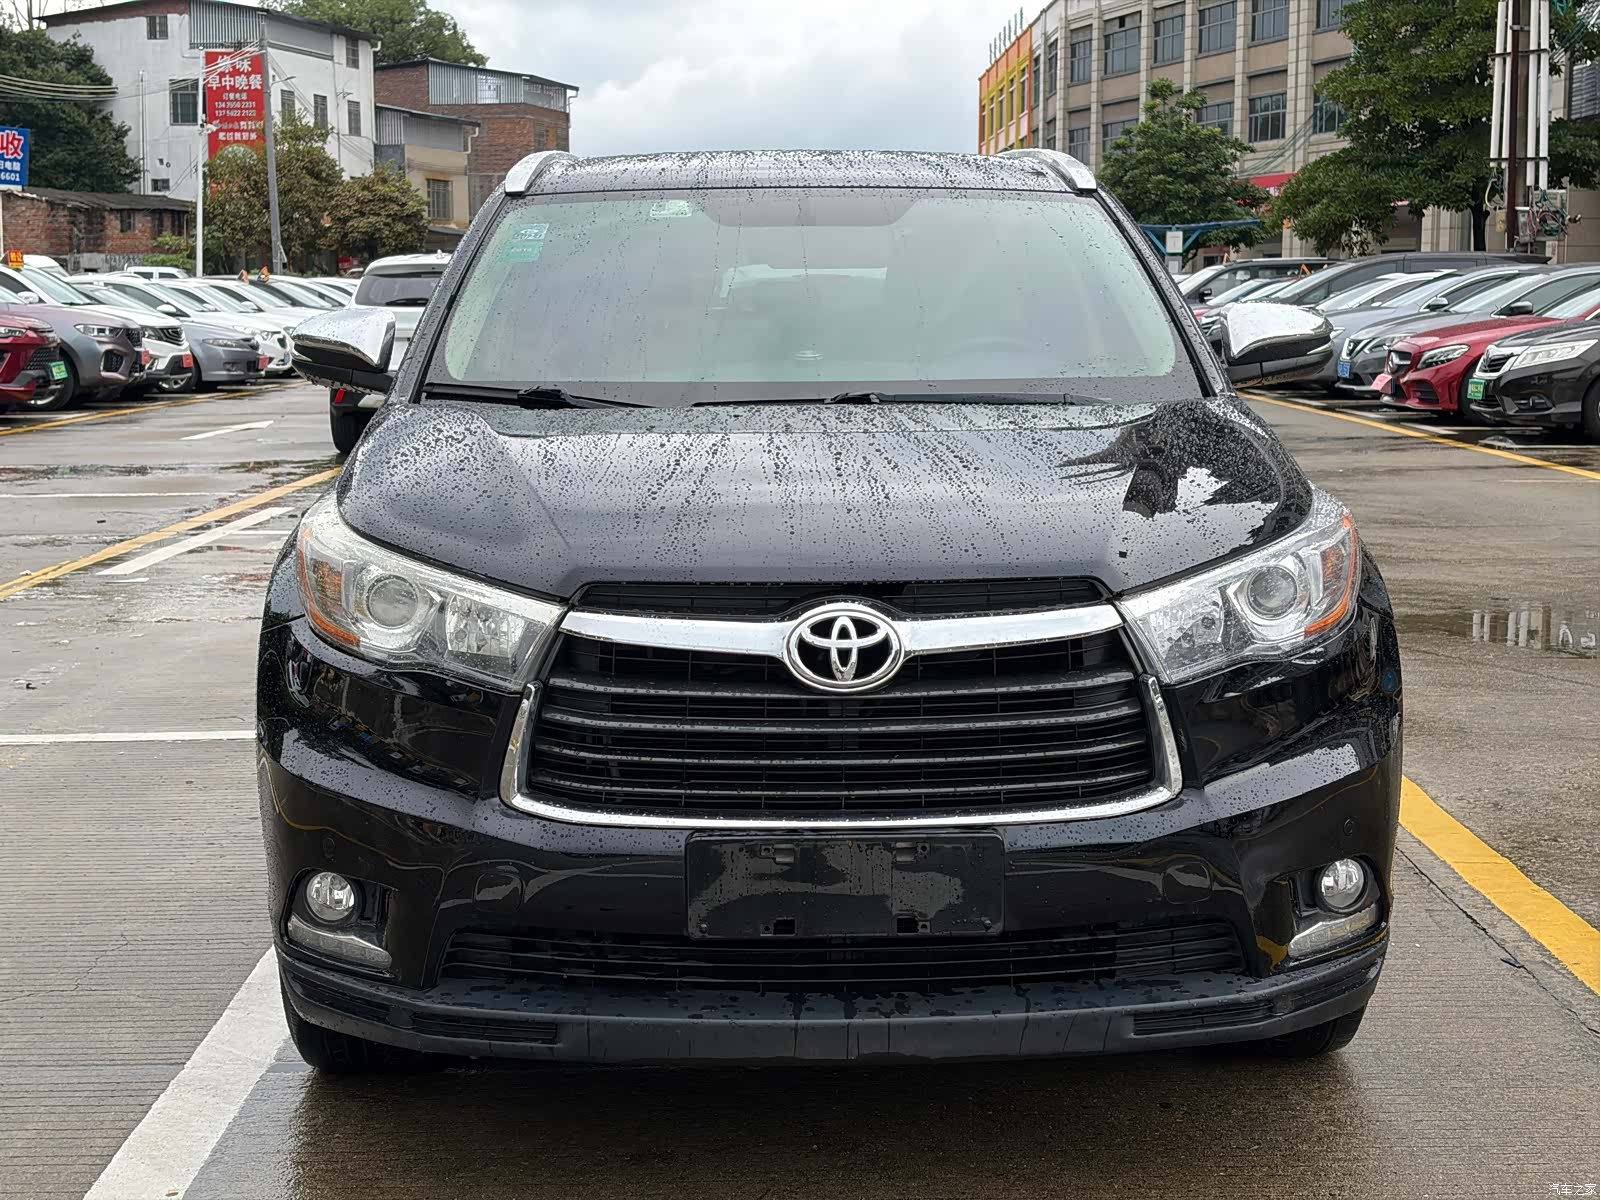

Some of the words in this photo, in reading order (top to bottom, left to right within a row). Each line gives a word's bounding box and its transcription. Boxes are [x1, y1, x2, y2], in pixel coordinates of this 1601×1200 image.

[207, 74, 262, 91] 早中晚餐
[0, 130, 24, 159] 收
